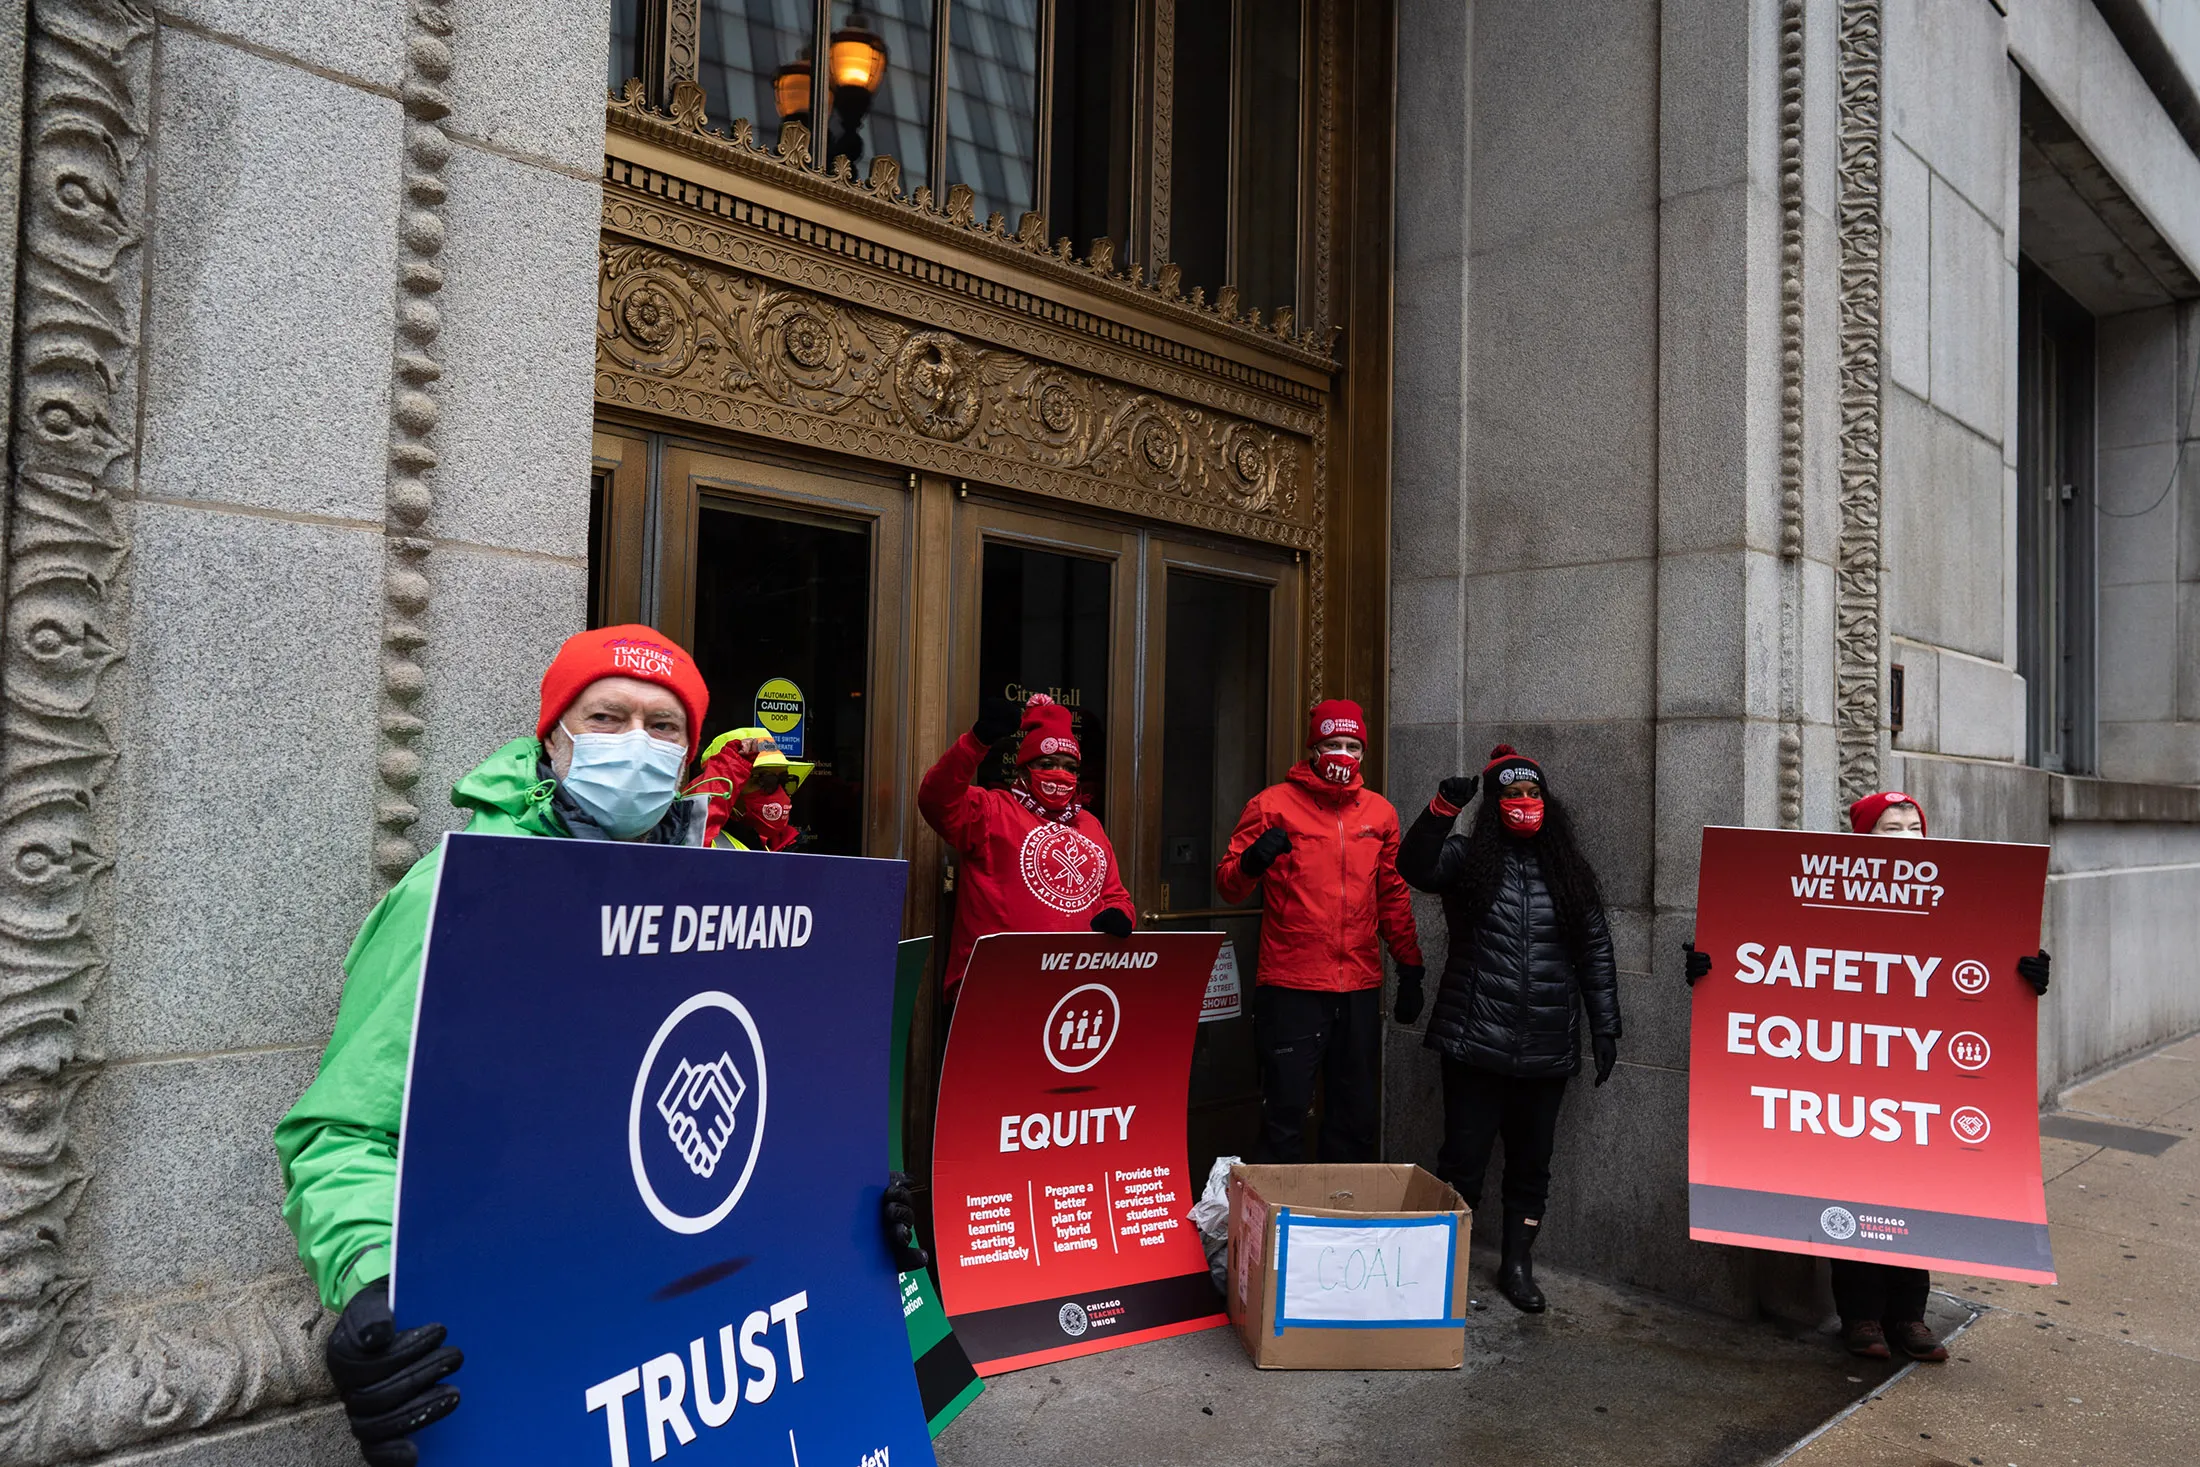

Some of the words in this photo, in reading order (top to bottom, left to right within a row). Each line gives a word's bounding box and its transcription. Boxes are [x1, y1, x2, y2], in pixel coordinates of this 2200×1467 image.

[613, 646, 674, 666] TEACHERS
[614, 655, 672, 677] UNION
[763, 691, 797, 700] AUTOMATIC
[1004, 683, 1035, 702] Cit
[1048, 687, 1080, 707] Hall
[761, 701, 799, 712] CAUTION
[771, 714, 788, 722] DOOR
[777, 743, 794, 751] ERATE
[1326, 762, 1351, 781] CTU
[1025, 831, 1045, 878] CHICAGO
[1800, 854, 1887, 879] WHAT
[1893, 859, 1939, 883] DO
[1038, 888, 1057, 902] AFT
[1059, 899, 1086, 908] LOCAL
[1790, 876, 1835, 899] WE
[1842, 879, 1945, 907] WANT?
[601, 905, 664, 957] WE
[670, 905, 813, 953] DEMAND
[1040, 952, 1073, 970] WE
[1074, 952, 1159, 970] DEMAND
[1734, 942, 1943, 998] SAFETY
[1202, 997, 1227, 1009] SHOW
[1727, 1011, 1943, 1072] EQUITY
[1750, 1085, 1941, 1146] TRUST
[999, 1105, 1137, 1153] EQUITY
[1115, 1167, 1152, 1182] Provide
[1153, 1165, 1170, 1177] the
[1045, 1185, 1086, 1199] Prepare
[1086, 1183, 1094, 1192] a
[1124, 1180, 1163, 1195] support
[966, 1193, 1013, 1209] Improve
[1054, 1197, 1087, 1211] better
[1114, 1195, 1154, 1209] services
[1155, 1191, 1176, 1205] that
[970, 1206, 1011, 1221] remote
[1051, 1212, 1076, 1227] plan
[1077, 1210, 1092, 1221] for
[1126, 1206, 1168, 1221] students
[1859, 1215, 1905, 1227] CHICAGO
[968, 1220, 1015, 1236] learning
[1056, 1223, 1091, 1240] hybrid
[1120, 1223, 1140, 1236] and
[1141, 1218, 1179, 1235] parents
[1860, 1223, 1909, 1235] TEACHERS
[970, 1234, 1016, 1251] starting
[1140, 1233, 1165, 1247] need
[1860, 1231, 1893, 1241] UNION
[1053, 1237, 1098, 1253] learning
[960, 1247, 1030, 1267] immediately
[1318, 1246, 1419, 1291] COAL
[904, 1278, 919, 1297] and
[1086, 1299, 1121, 1312] CHICAGO
[1088, 1307, 1126, 1320] TEACHERS
[1091, 1317, 1117, 1328] UNION
[585, 1289, 809, 1467] TRUST
[857, 1445, 890, 1467] fety
